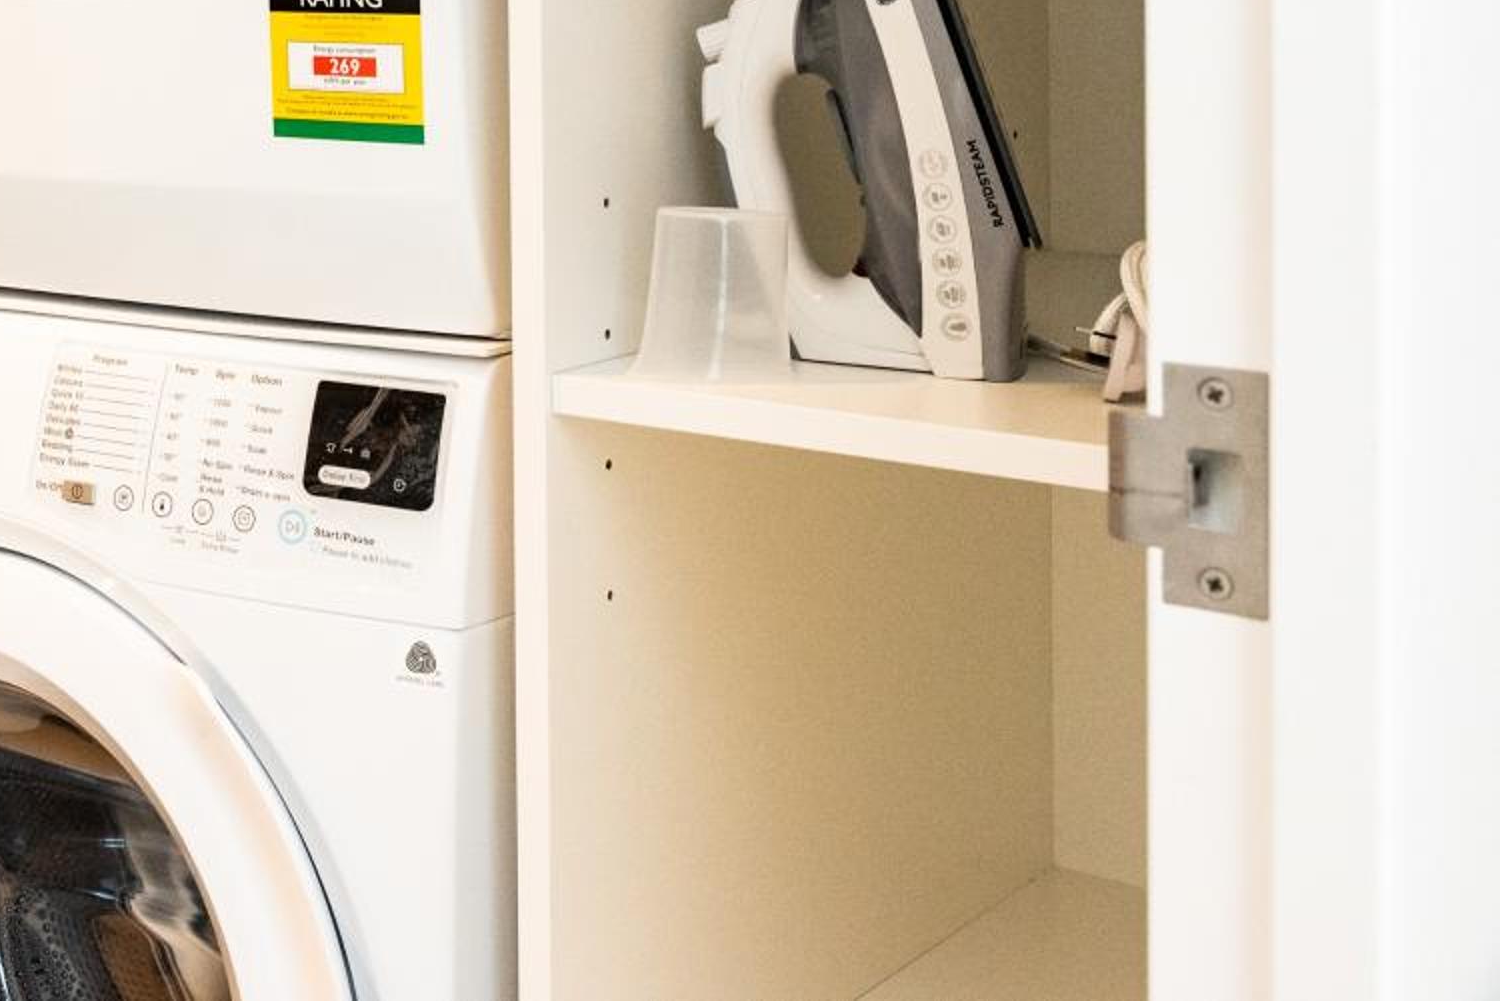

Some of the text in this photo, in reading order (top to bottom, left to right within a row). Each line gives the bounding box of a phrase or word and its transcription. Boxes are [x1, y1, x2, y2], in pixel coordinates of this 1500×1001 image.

[329, 58, 361, 77] 269
[966, 139, 1005, 229] RAPIDSTEAM
[313, 526, 376, 546] Start/Pause
